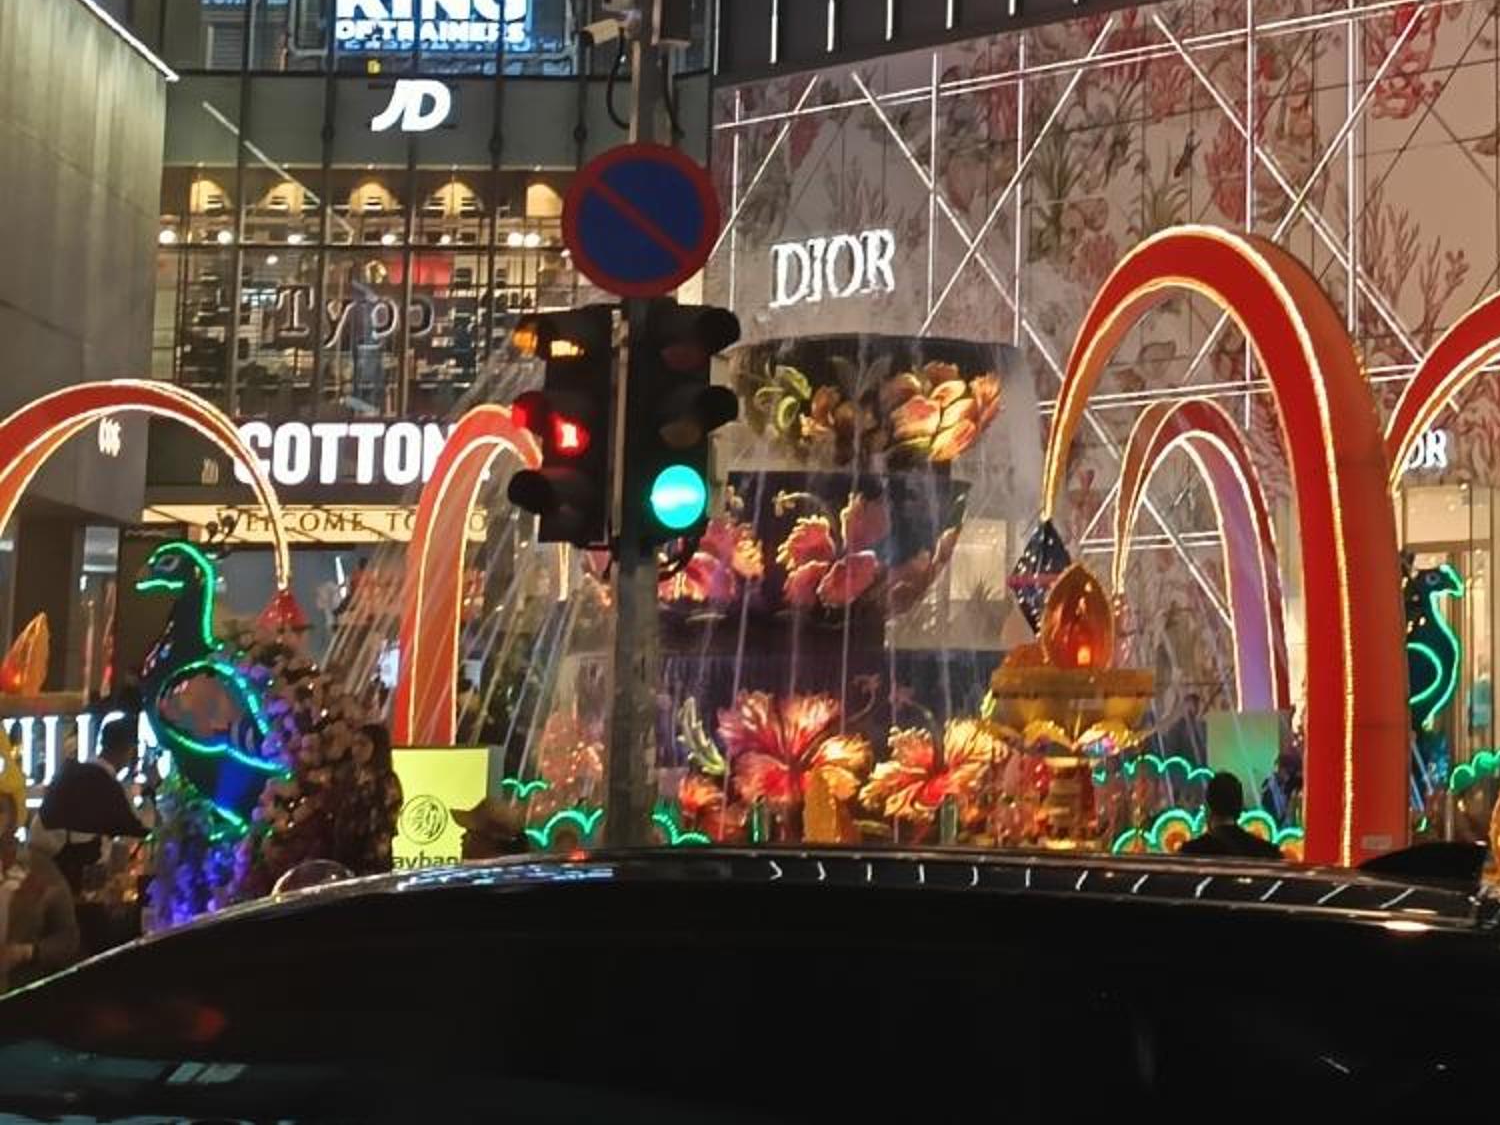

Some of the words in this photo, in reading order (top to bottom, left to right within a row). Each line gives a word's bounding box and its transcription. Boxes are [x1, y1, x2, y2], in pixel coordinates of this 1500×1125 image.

[371, 78, 451, 132] JD
[769, 228, 896, 309] DIOR
[276, 282, 435, 350] Typo
[232, 422, 460, 485] COTTON
[392, 850, 461, 870] ayban
